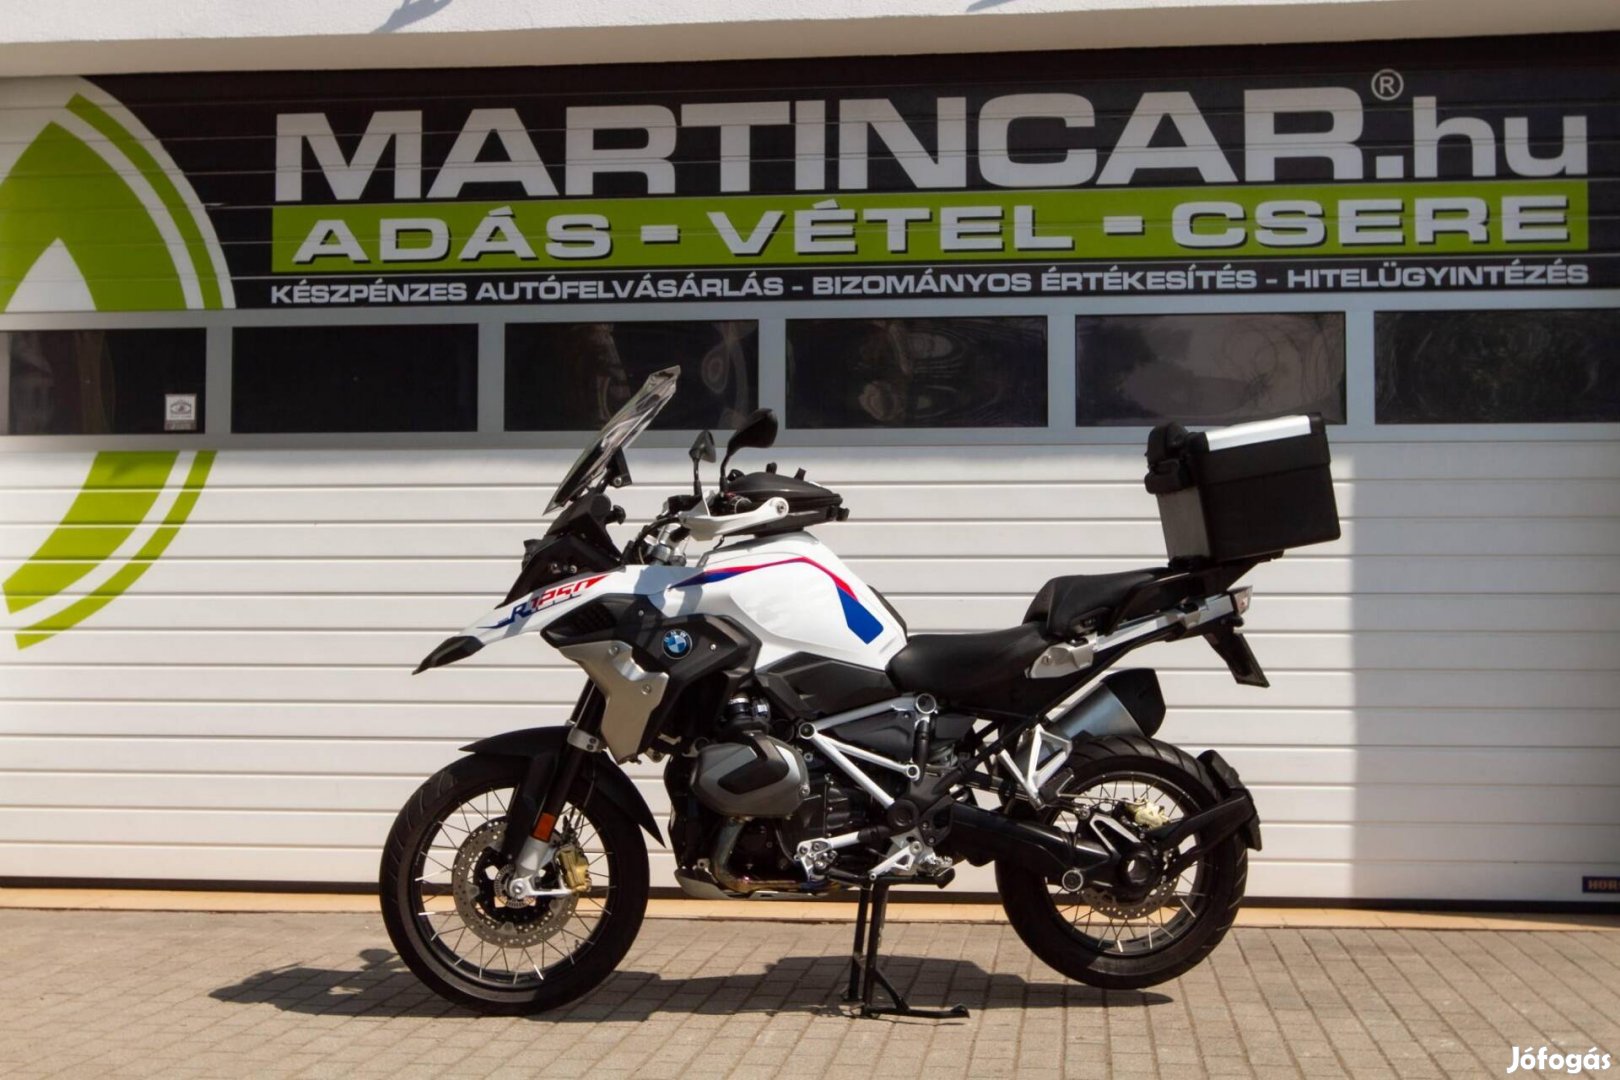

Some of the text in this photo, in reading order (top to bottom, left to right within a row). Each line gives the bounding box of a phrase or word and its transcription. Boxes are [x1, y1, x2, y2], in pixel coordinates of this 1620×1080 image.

[293, 195, 1571, 264] ADÁS - VÉTEL - CSERE
[270, 279, 467, 304] KÉSZPÉNZES
[475, 271, 784, 301] AUTÓFELVÁSÁRLÁS
[812, 269, 1032, 297] BIZOMÁNYOS
[1040, 263, 1257, 292] ÉRTÉKESÍTÉS
[1287, 258, 1589, 289] HITELÜGYINTÉZÉS
